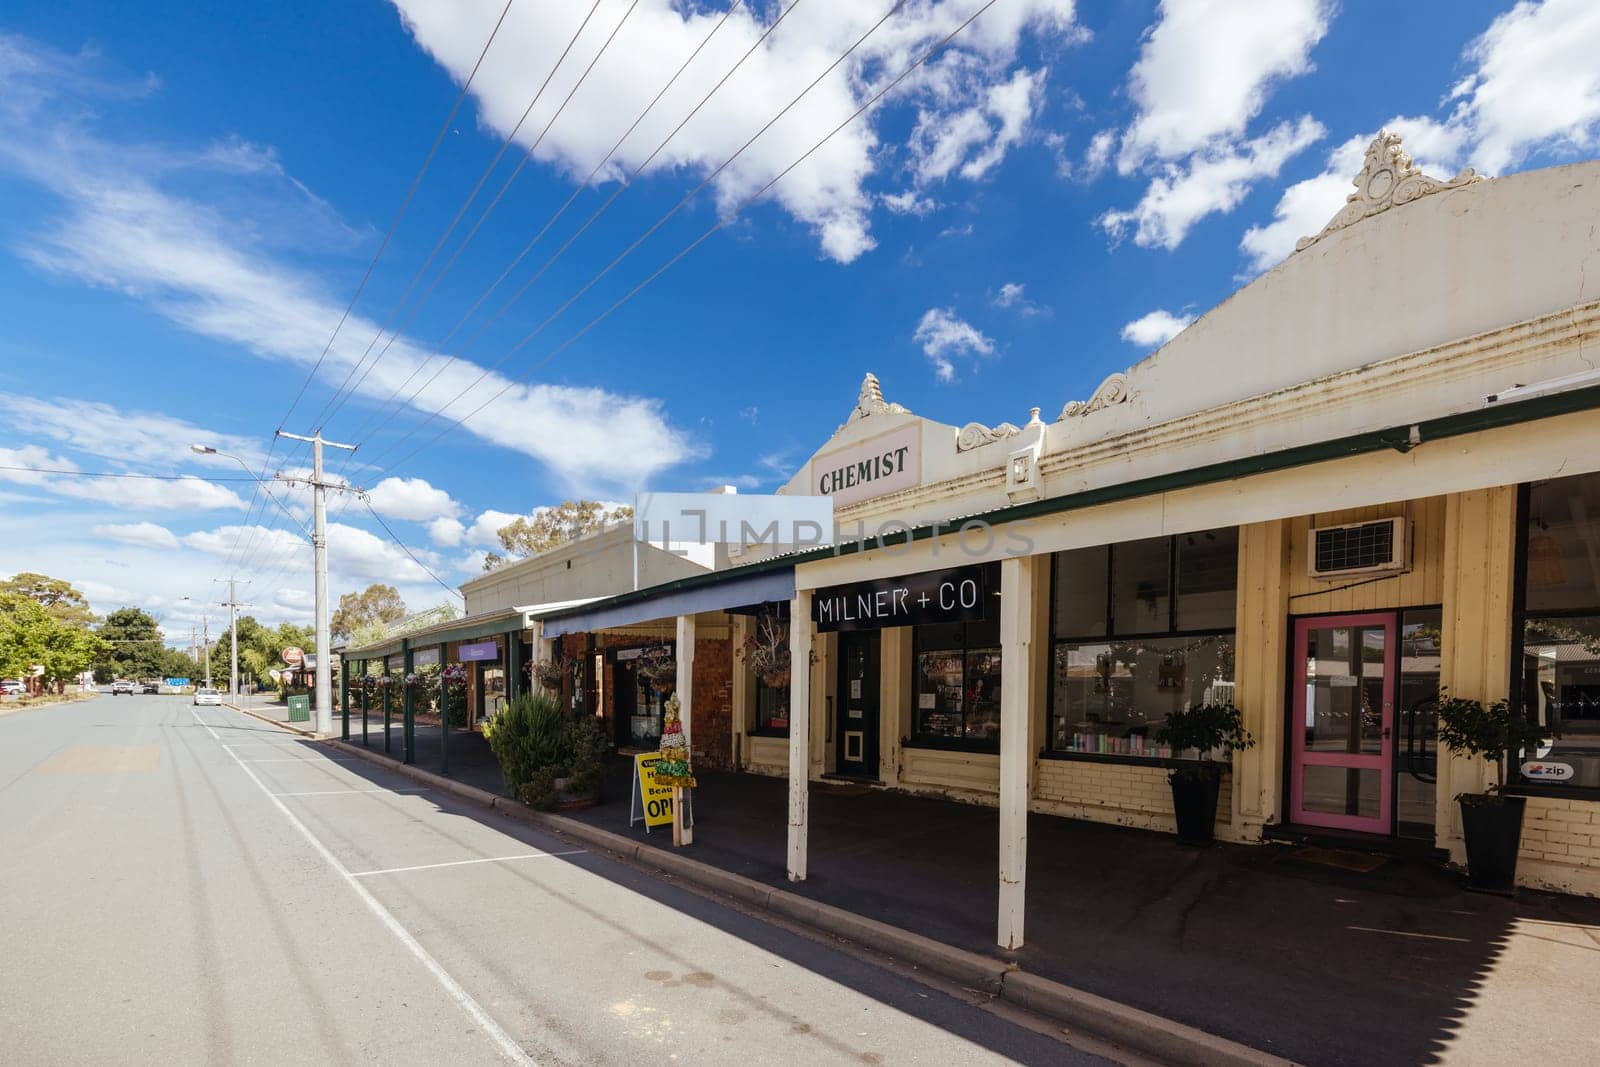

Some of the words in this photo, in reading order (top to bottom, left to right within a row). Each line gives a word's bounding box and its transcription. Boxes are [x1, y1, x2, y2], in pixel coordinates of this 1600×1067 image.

[819, 446, 908, 495] CHEMIST
[819, 588, 909, 623] MILNER
[917, 591, 930, 609] +
[939, 579, 977, 611] CO
[1545, 766, 1565, 776] zip
[648, 787, 673, 796] Beau
